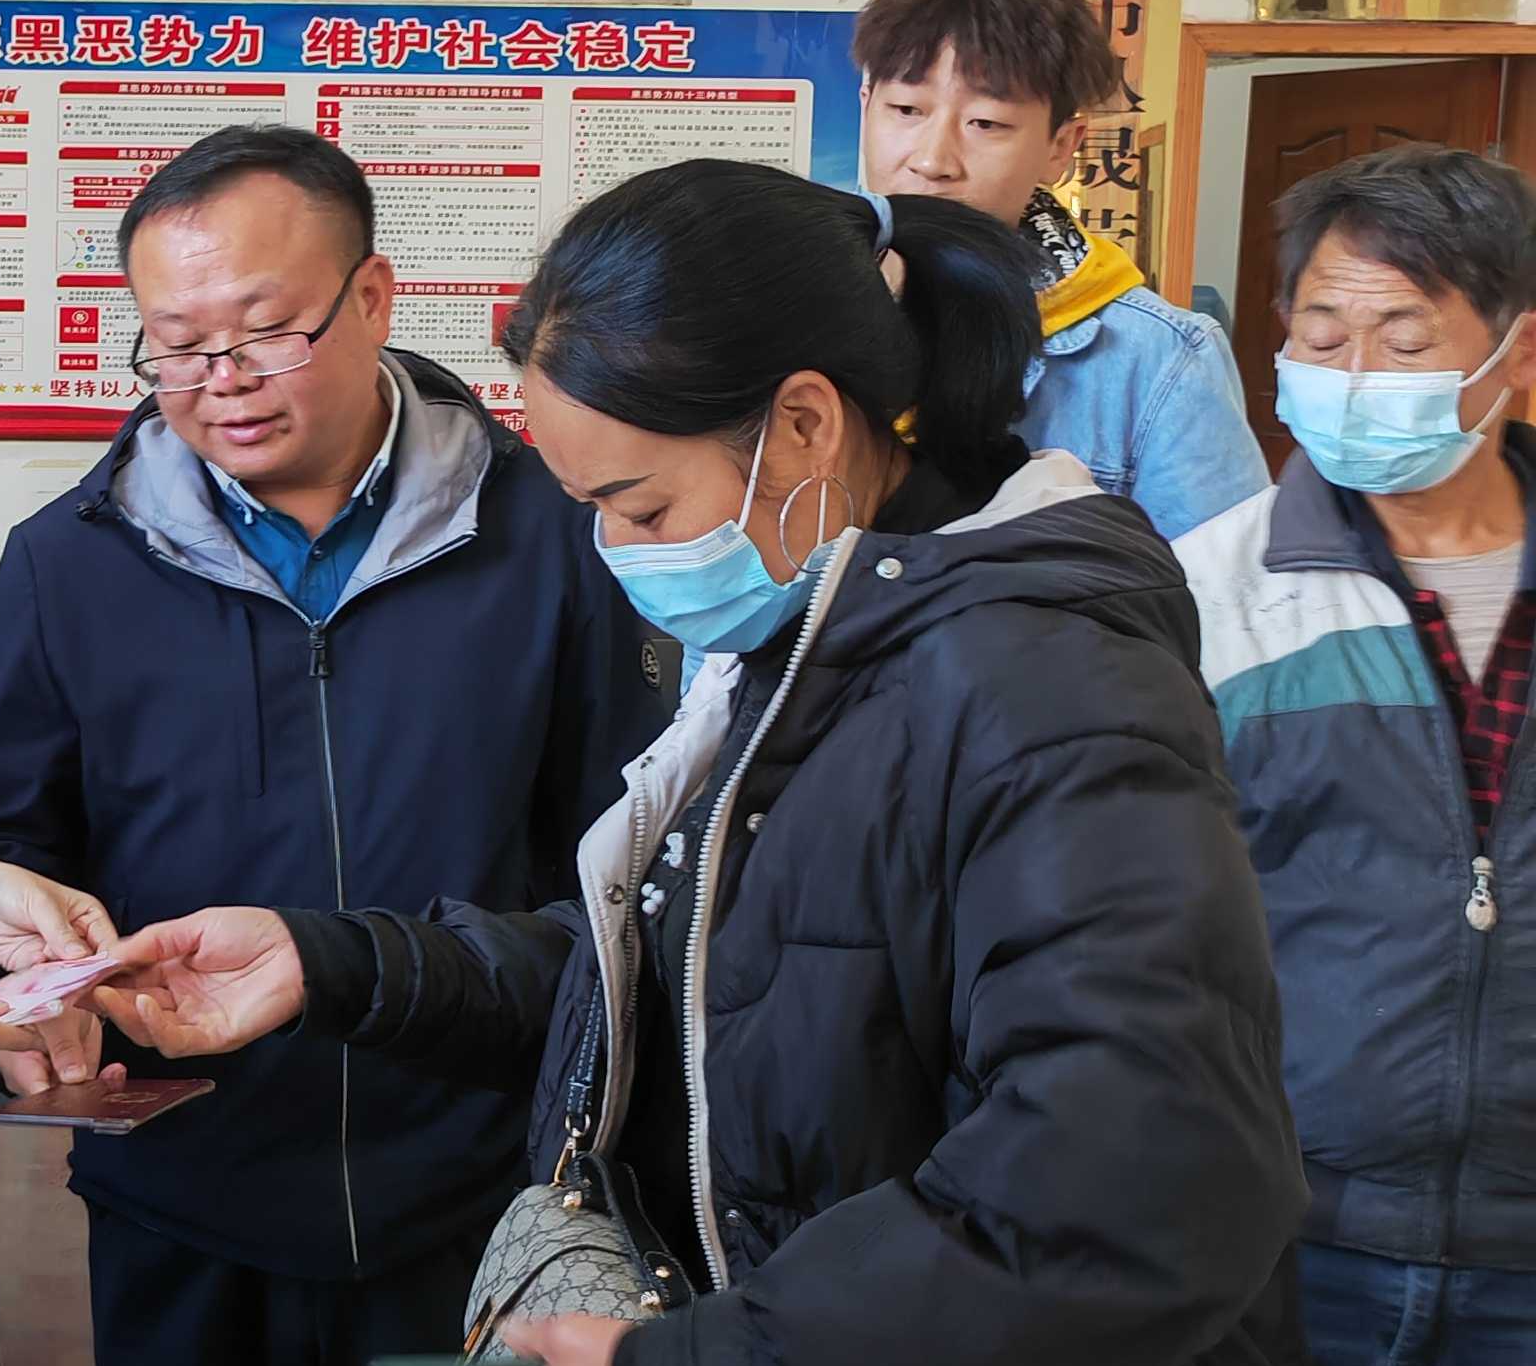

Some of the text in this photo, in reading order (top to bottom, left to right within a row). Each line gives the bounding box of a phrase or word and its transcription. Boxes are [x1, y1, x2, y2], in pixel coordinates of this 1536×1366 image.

[301, 18, 696, 72] 维护社会稳定
[118, 84, 228, 96] 黑恶势力的危害有哪些
[630, 89, 739, 101] 黑恶势力的十三种类型
[325, 104, 333, 117] 1
[322, 123, 332, 136] 2
[49, 379, 146, 399] 坚持以人
